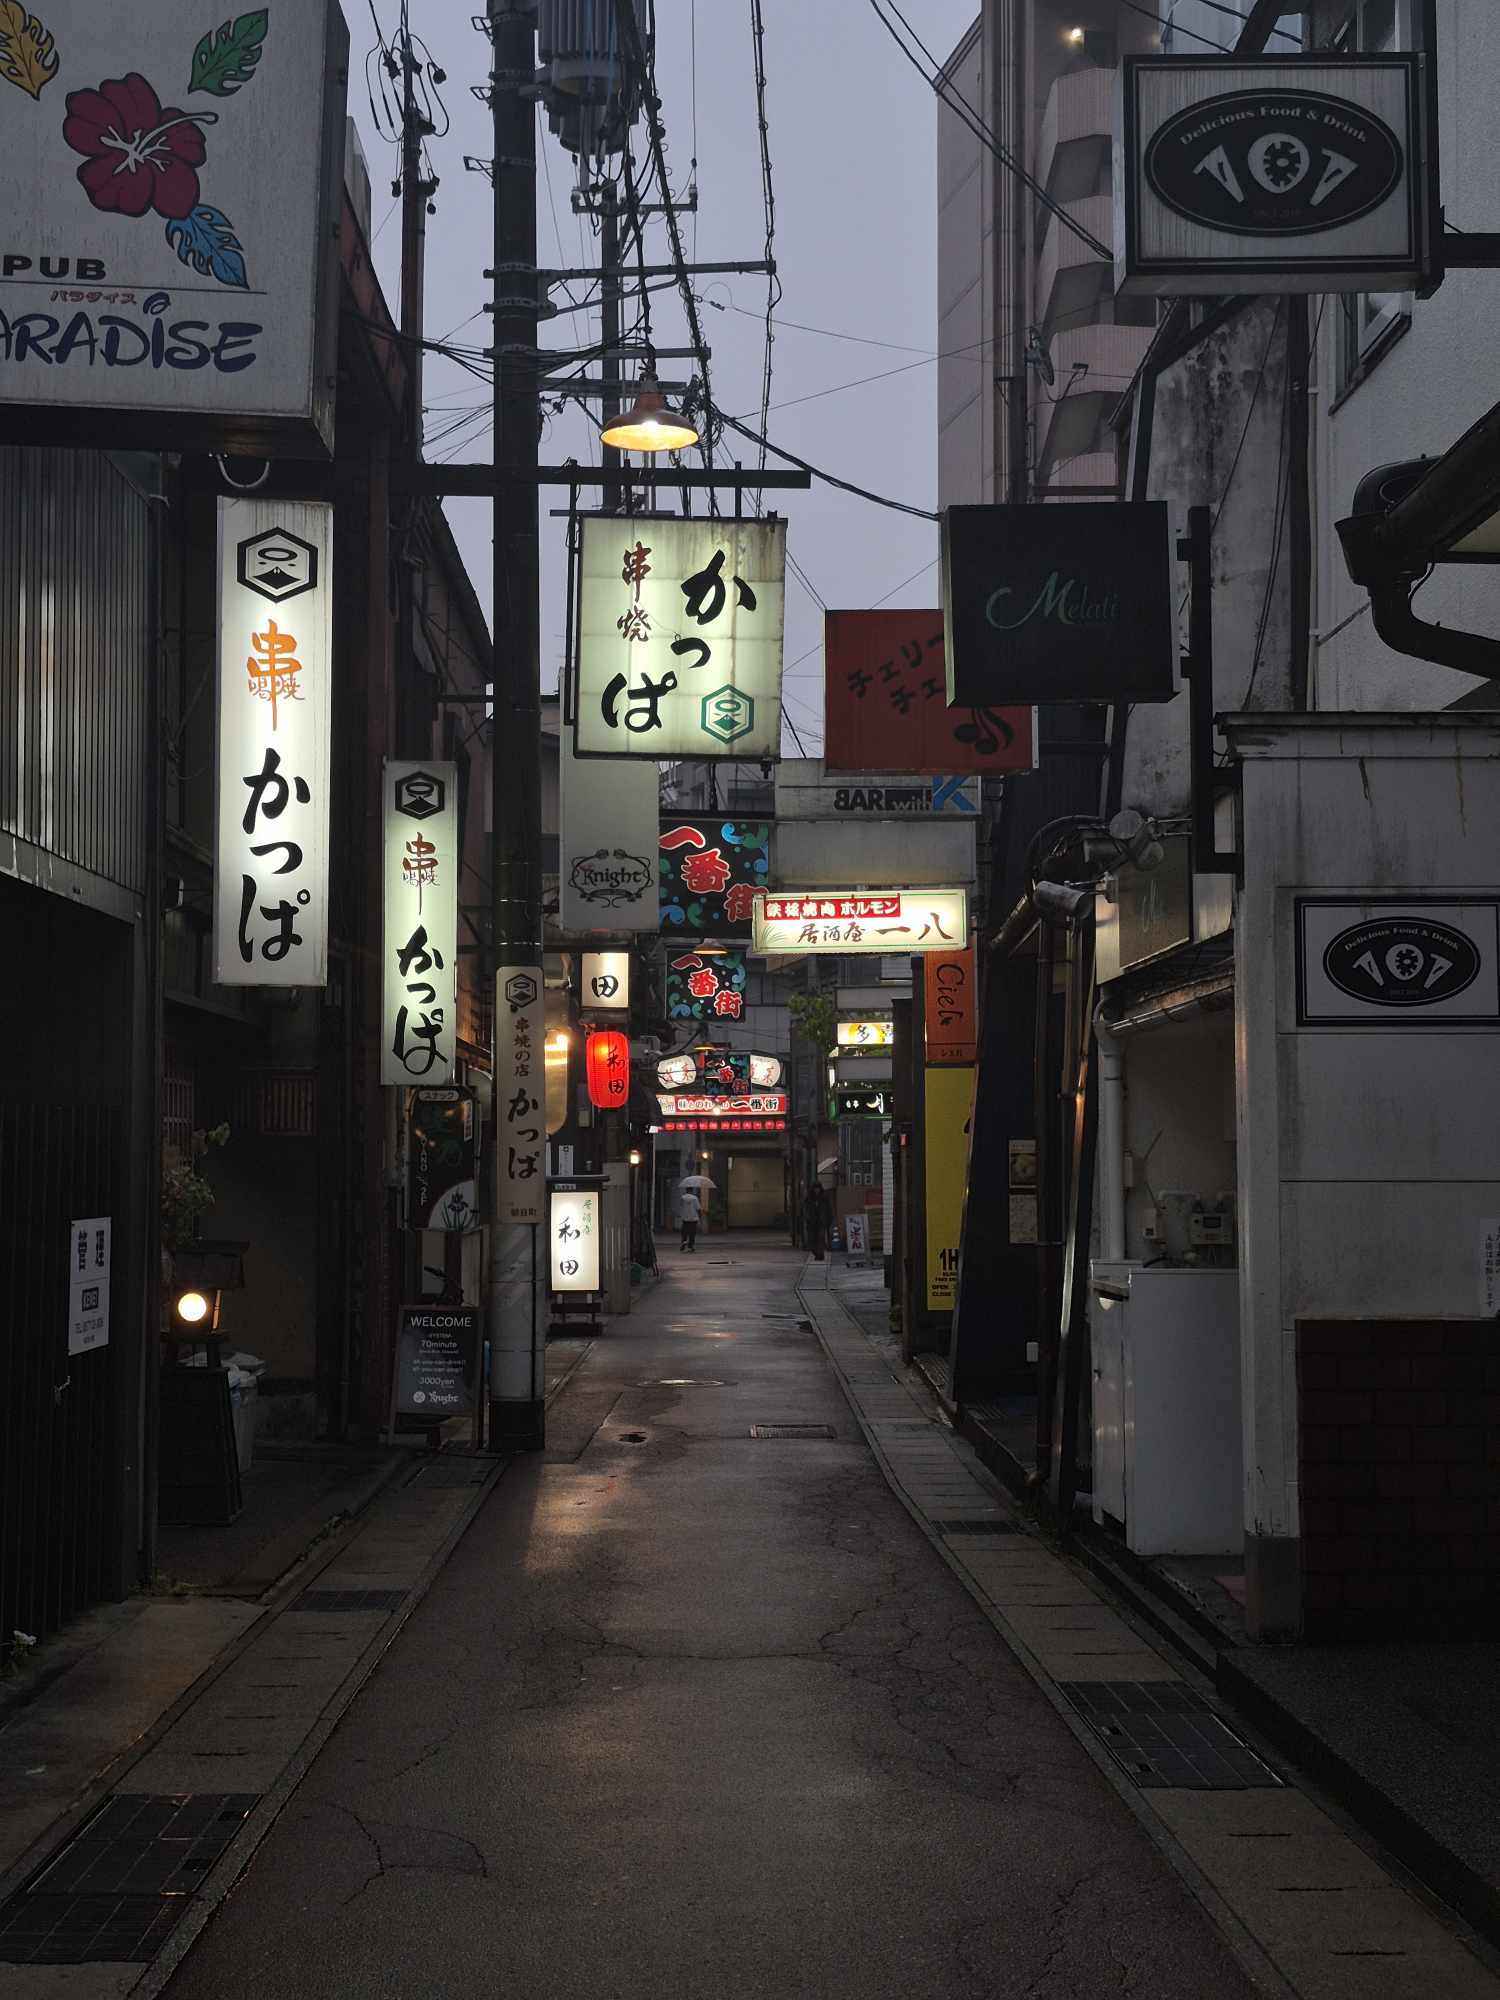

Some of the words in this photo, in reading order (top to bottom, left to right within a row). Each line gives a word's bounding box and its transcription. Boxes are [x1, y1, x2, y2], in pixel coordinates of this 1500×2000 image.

[1180, 108, 1255, 145] Delicious
[1259, 104, 1301, 118] Food
[1306, 108, 1320, 121] &
[1324, 113, 1368, 143] Drink
[2, 254, 107, 281] PUB
[50, 289, 137, 304] パラダイス
[601, 548, 757, 734] かっぱ
[932, 775, 977, 811] K
[238, 747, 311, 964] かっぱ
[580, 865, 642, 888] Knight
[392, 923, 449, 1076] かっぱ
[671, 953, 743, 1018] 一番街
[513, 1017, 532, 1078] 串焼の店
[508, 1087, 540, 1180] かっぱ
[558, 1216, 581, 1276] 和田
[410, 1316, 473, 1328] WELCOME
